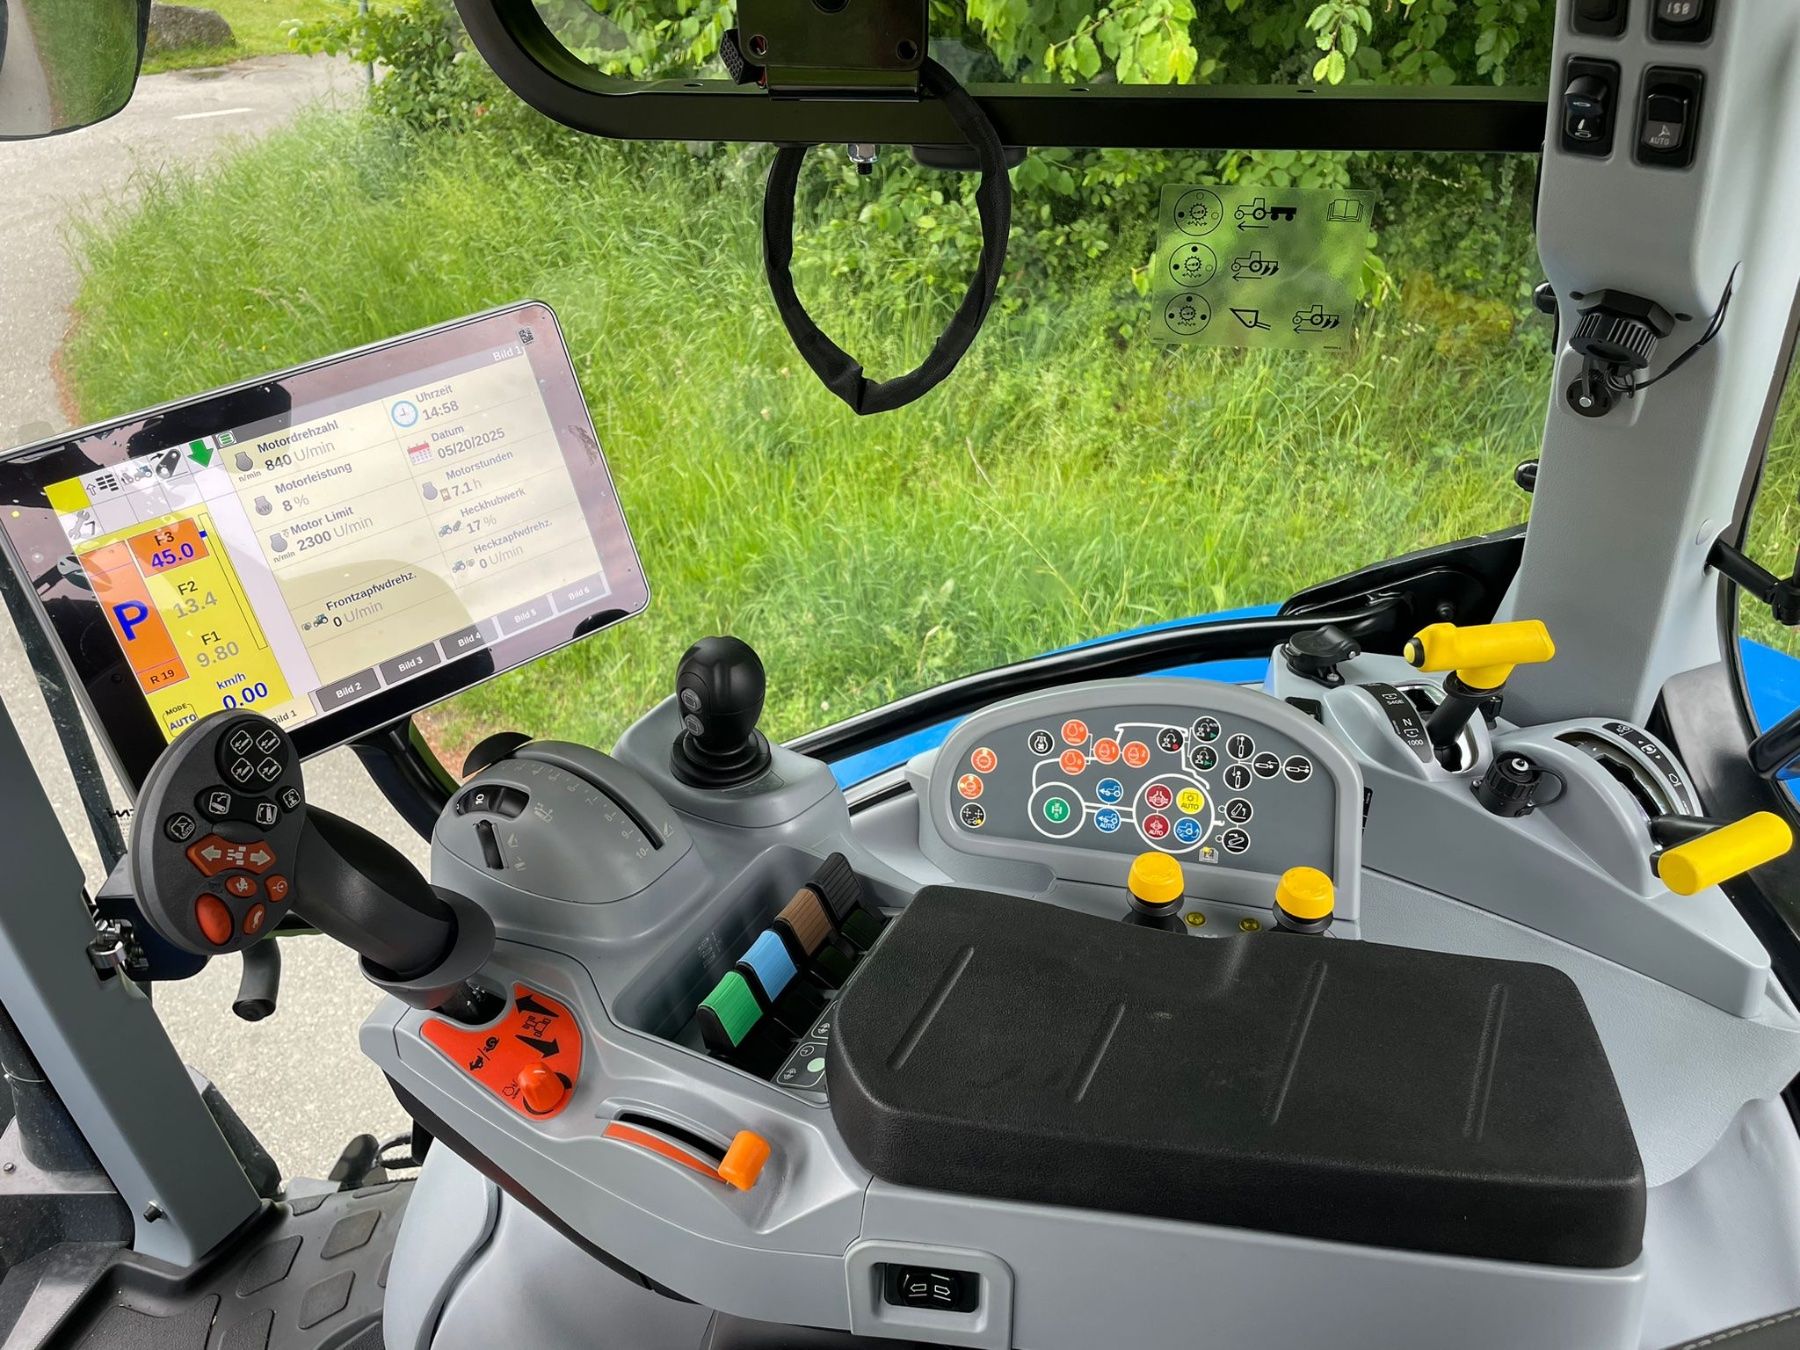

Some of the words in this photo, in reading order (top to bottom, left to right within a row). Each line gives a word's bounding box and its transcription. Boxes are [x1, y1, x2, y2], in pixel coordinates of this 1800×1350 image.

[1649, 136, 1670, 146] AUTO
[492, 346, 513, 361] Bild
[415, 384, 453, 403] Uhrzeit
[422, 400, 460, 421] 14:58
[257, 420, 339, 453] Motordrehzahl
[431, 425, 465, 442] Datum
[437, 427, 506, 459] 05/20/2025
[265, 454, 292, 471] 840
[294, 441, 336, 461] U/min
[445, 450, 514, 480] Motorstunden
[275, 463, 353, 494] Motorleistung
[452, 482, 473, 497] 7.1
[473, 478, 483, 489] h
[282, 500, 293, 511] 8
[294, 495, 310, 507] %
[460, 487, 526, 517] Heckhubwerk
[290, 518, 323, 536] Motor
[325, 507, 354, 523] Limit
[467, 520, 482, 534] 17
[483, 515, 497, 526] %
[155, 531, 175, 546] F3
[296, 531, 332, 551] 2300
[333, 516, 374, 538] U/min
[473, 518, 553, 555] Heckzapfwdrehz.
[151, 543, 195, 569] 45.0
[479, 558, 488, 569] 0
[488, 545, 524, 565] U/min
[177, 580, 198, 596] F2
[326, 570, 417, 612] Frontzapfwdrehz.
[173, 591, 218, 619] 13.4
[333, 616, 343, 628] 0
[343, 600, 384, 624] U/min
[112, 600, 149, 641] P
[201, 630, 221, 646] F1
[458, 634, 476, 648] Bild
[474, 632, 482, 641] 4
[196, 640, 240, 668] 9.80
[398, 659, 417, 673] Bild
[416, 657, 424, 666] 3
[150, 675, 160, 685] R
[162, 669, 175, 681] 19
[216, 671, 246, 690] km/h
[222, 681, 269, 712] 0.00
[336, 684, 354, 699] Bild
[354, 682, 363, 691] 2
[165, 703, 188, 716] MODE
[290, 709, 298, 718] 1
[169, 713, 198, 731] AUTO
[1402, 718, 1413, 727] N
[1181, 802, 1200, 811] AUTO
[1099, 822, 1116, 830] AUTO
[1148, 829, 1164, 837] AUTO
